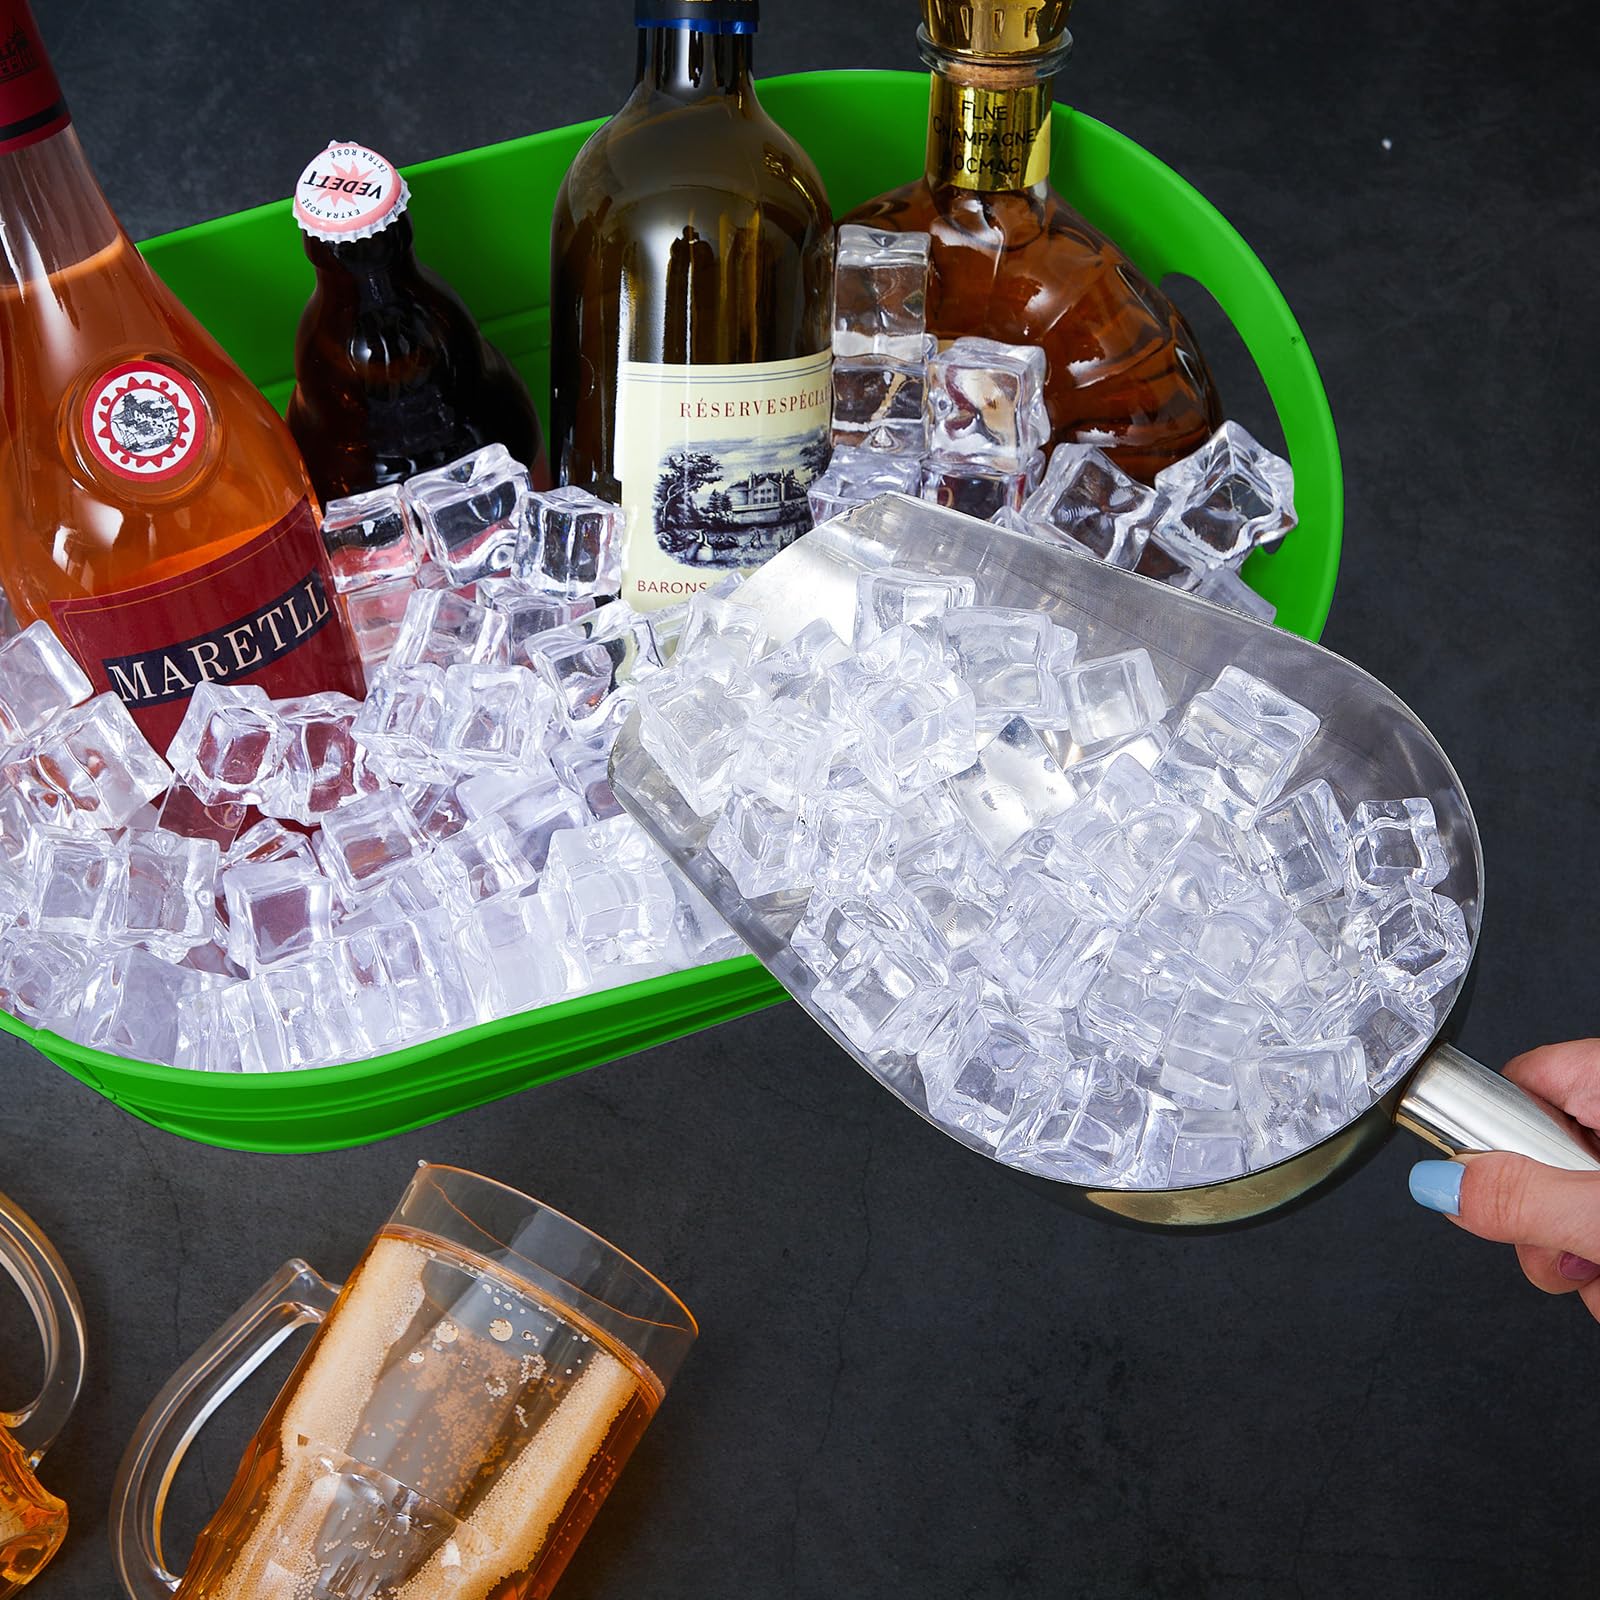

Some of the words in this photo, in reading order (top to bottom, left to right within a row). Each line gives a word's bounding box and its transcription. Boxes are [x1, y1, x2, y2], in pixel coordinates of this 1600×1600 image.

[362, 151, 388, 173] EXTRA
[303, 170, 382, 200] VEDETT
[326, 208, 361, 219] EXTRA
[637, 579, 707, 595] BARONS
[107, 581, 329, 702] MARETLL
